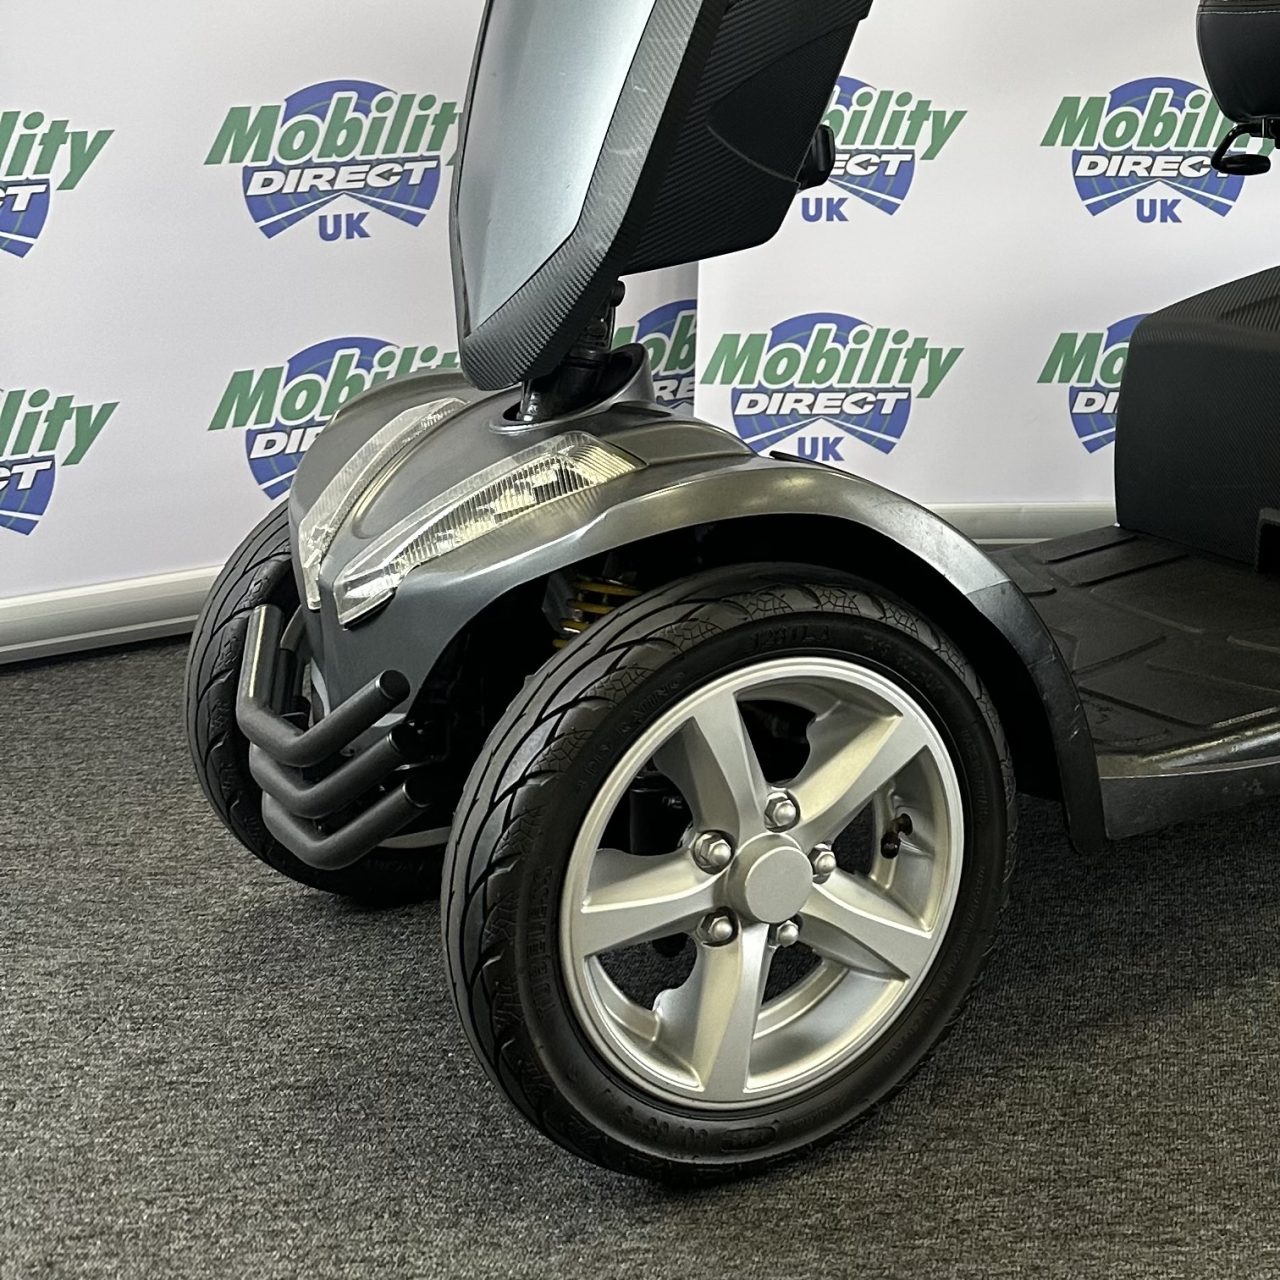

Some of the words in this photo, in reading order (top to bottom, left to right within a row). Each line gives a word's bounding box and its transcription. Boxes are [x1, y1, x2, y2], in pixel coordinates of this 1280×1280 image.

[203, 92, 461, 167] Mobilit
[246, 159, 437, 196] DIRECT
[1075, 155, 1229, 178] DIREC
[802, 198, 849, 222] UK
[1136, 199, 1182, 223] UK
[318, 213, 370, 242] UK
[700, 327, 965, 398] Mobility
[734, 392, 909, 415] DIRECT
[798, 437, 844, 461] UK
